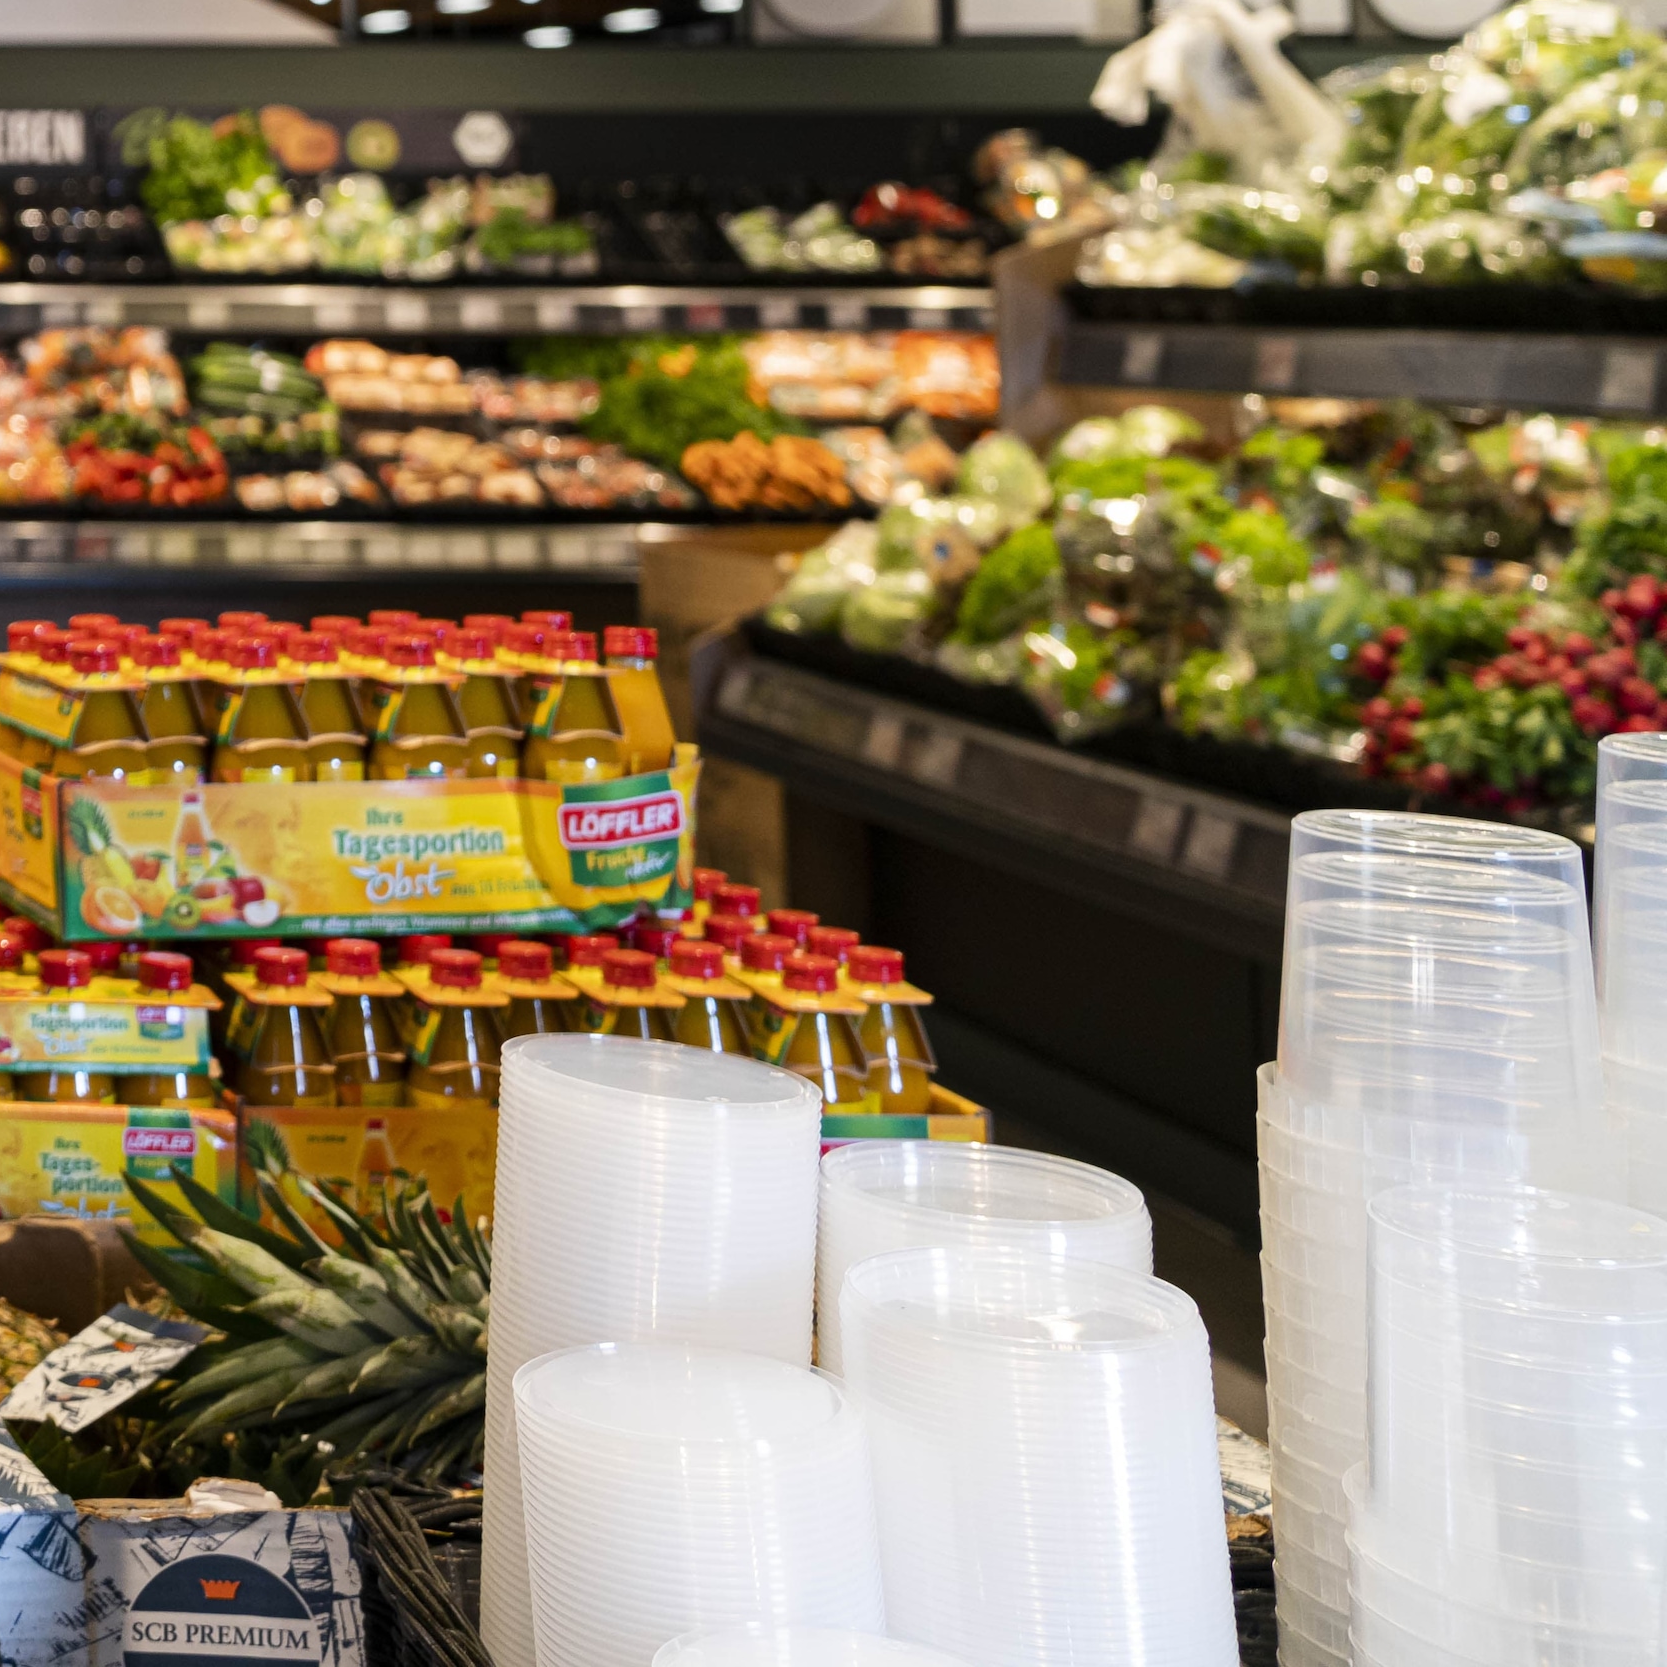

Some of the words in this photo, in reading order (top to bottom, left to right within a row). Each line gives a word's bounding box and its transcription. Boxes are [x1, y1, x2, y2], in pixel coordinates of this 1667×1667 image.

[366, 807, 404, 826] Ihre
[568, 801, 676, 841] LÖFFLER
[332, 828, 505, 860] Tagesportion
[357, 862, 456, 905] Obst
[126, 1132, 193, 1151] LÖFFLER
[40, 1151, 101, 1175] Tages-
[53, 1174, 125, 1196] portion
[131, 1621, 178, 1643] SCB
[185, 1623, 311, 1650] PREMIUM
